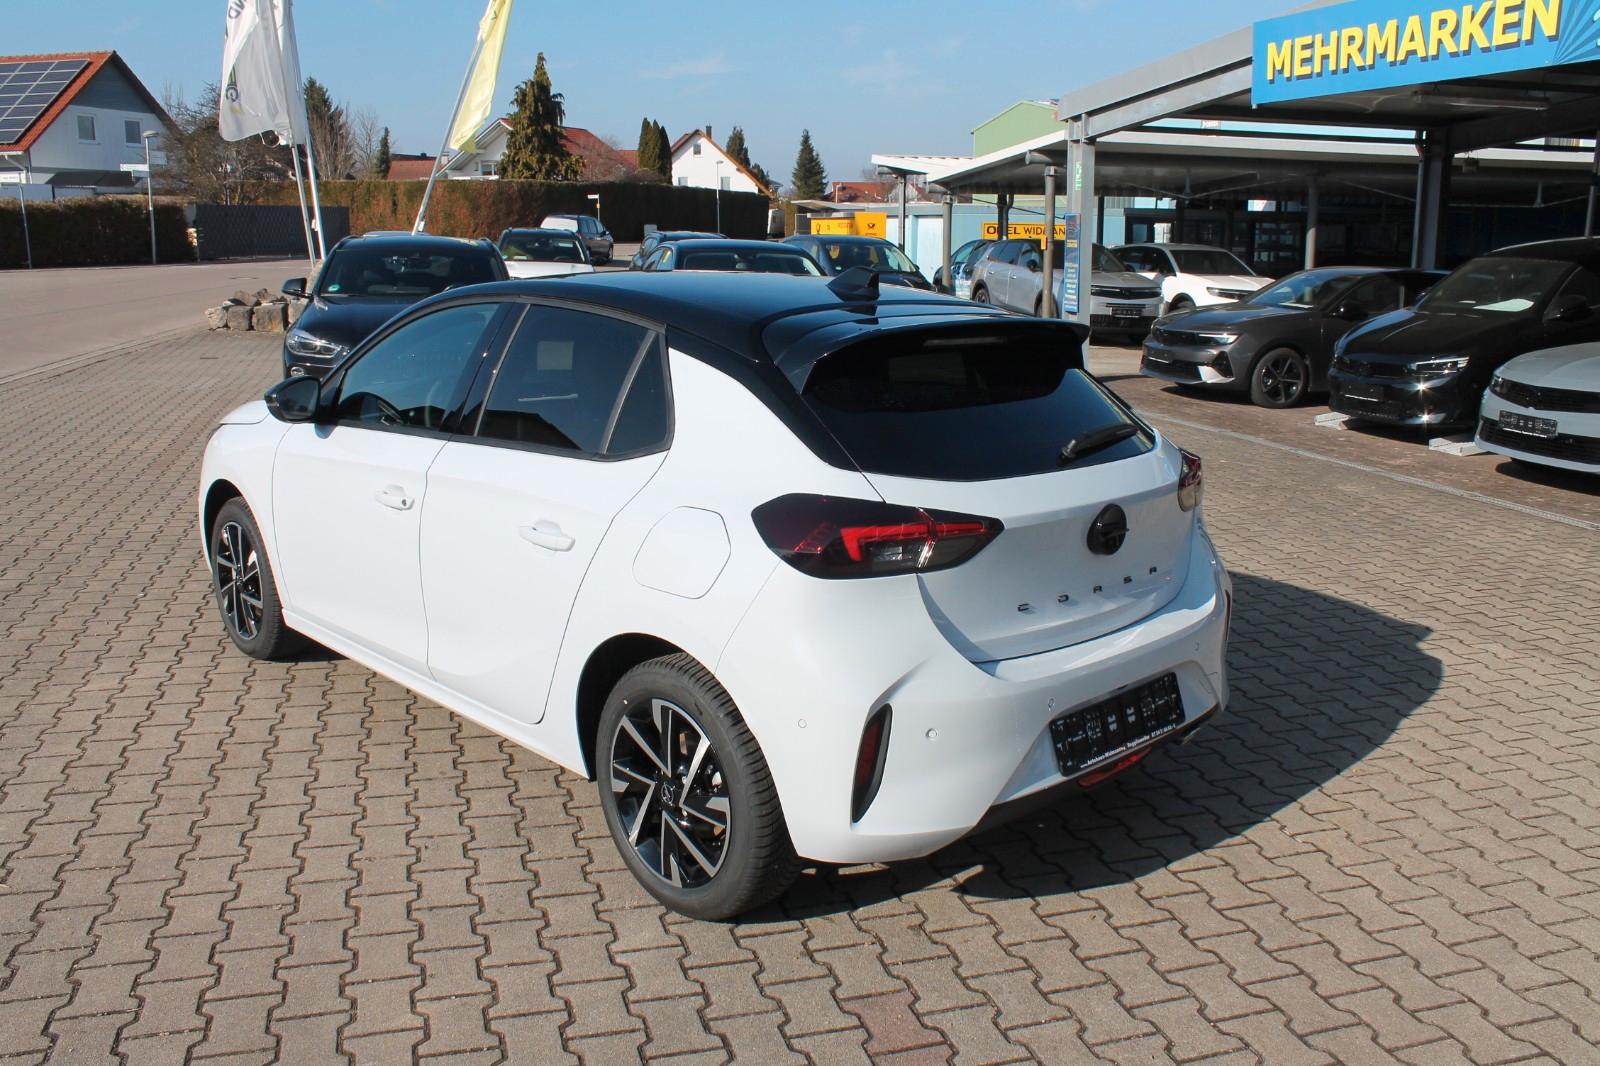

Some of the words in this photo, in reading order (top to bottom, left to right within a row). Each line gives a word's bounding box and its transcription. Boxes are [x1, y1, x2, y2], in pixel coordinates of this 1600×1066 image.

[1267, 0, 1562, 82] MEHRMARKEN
[986, 225, 1021, 235] OEL
[1017, 566, 1157, 612] CORSA
